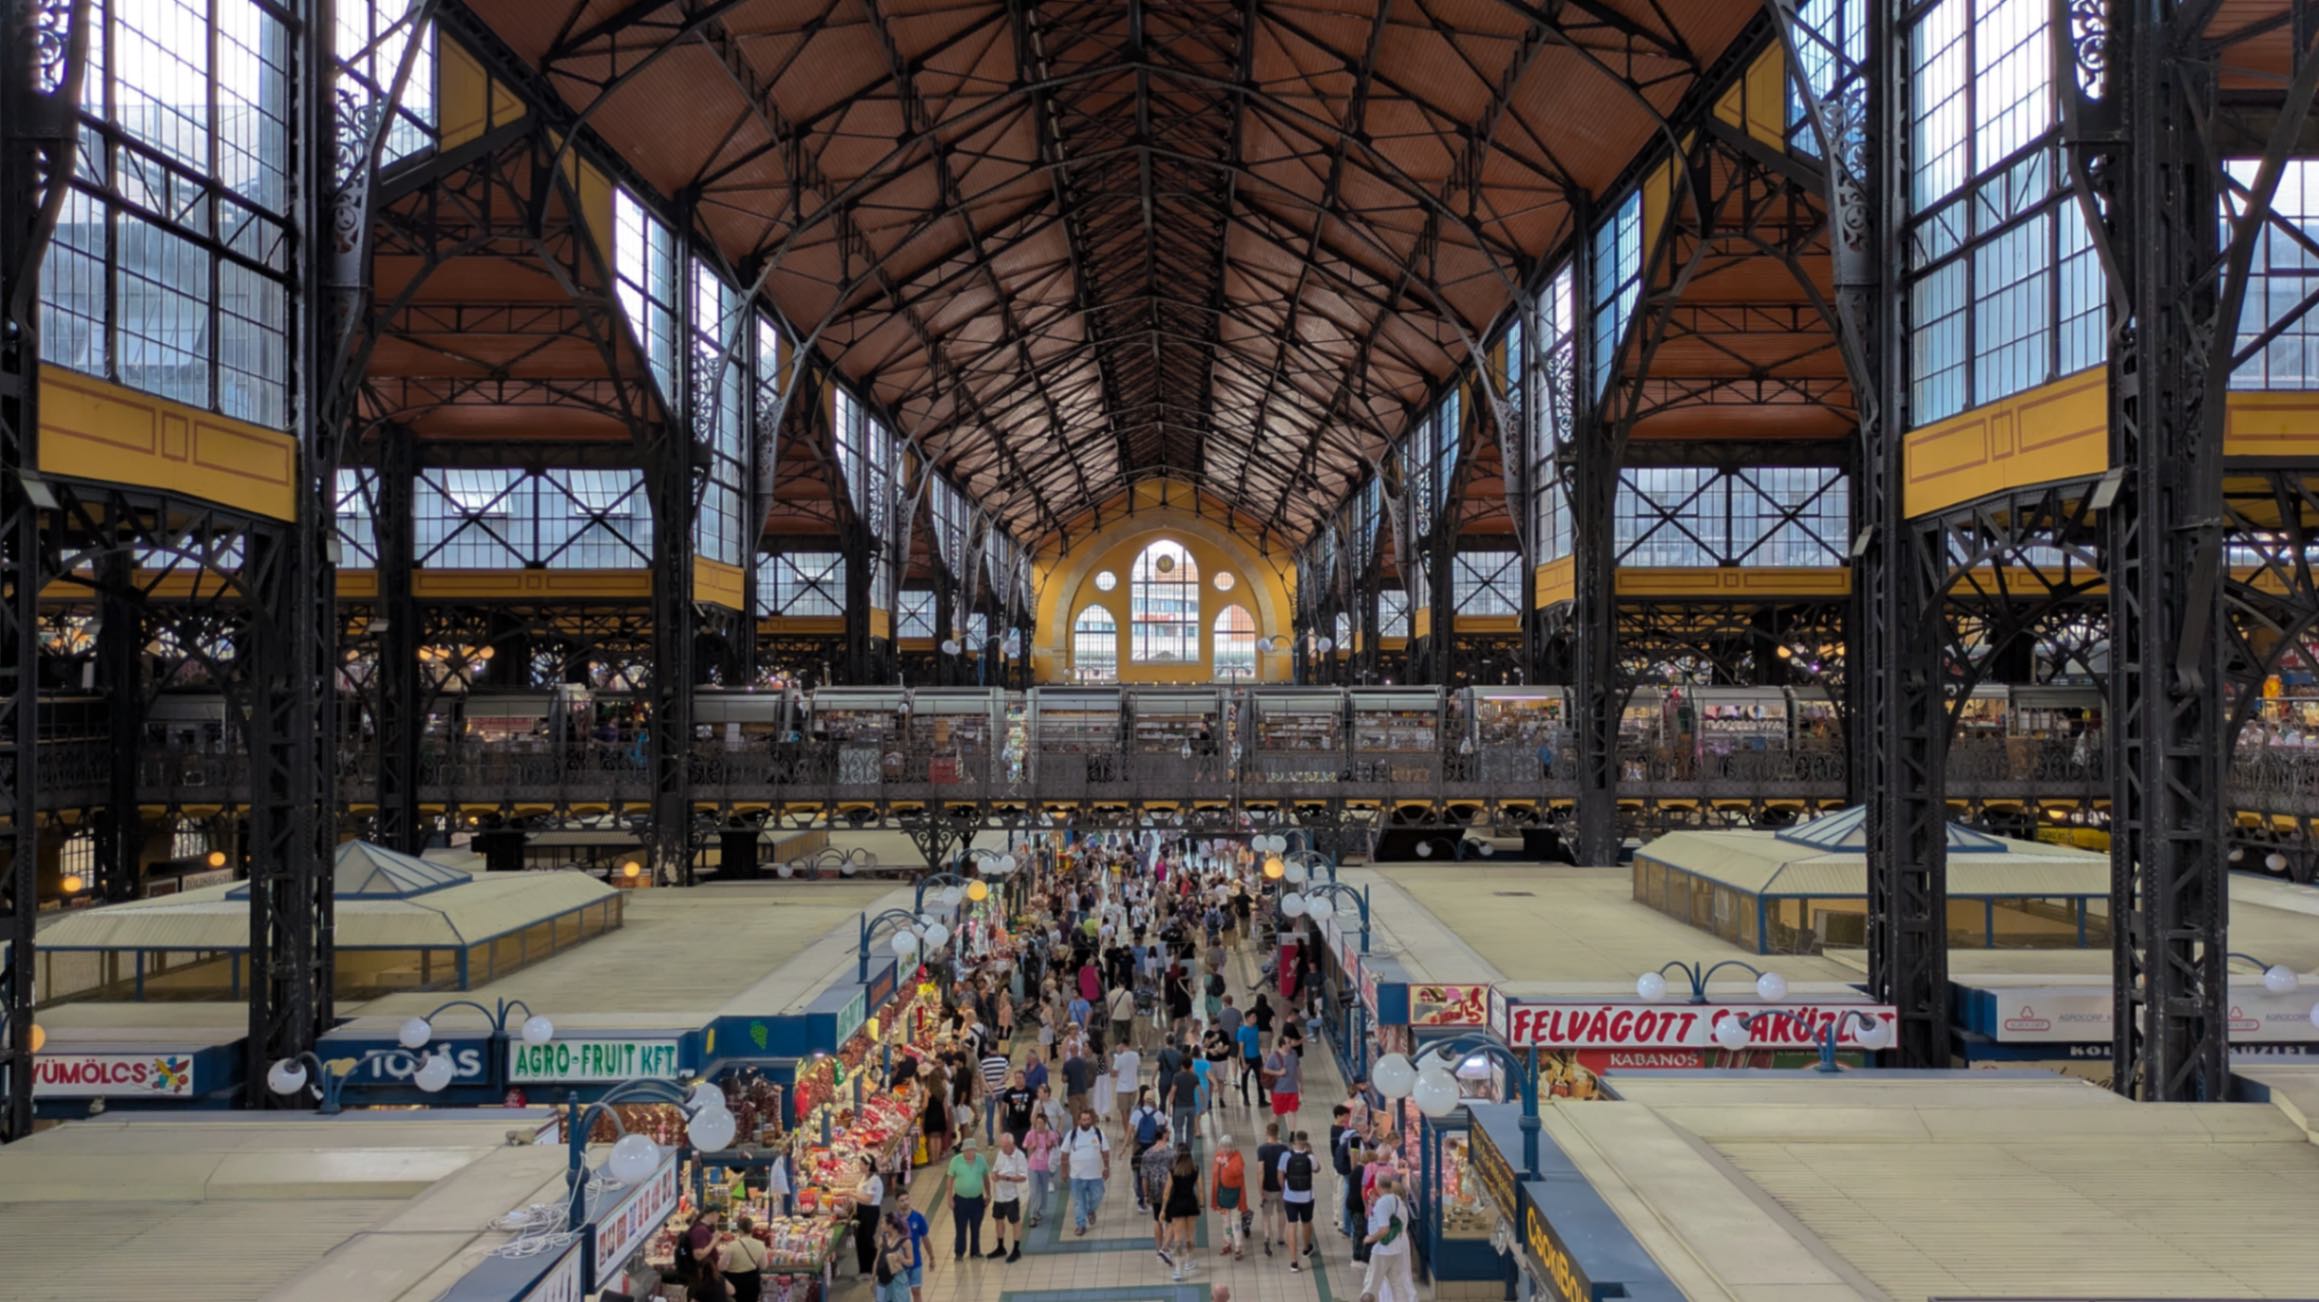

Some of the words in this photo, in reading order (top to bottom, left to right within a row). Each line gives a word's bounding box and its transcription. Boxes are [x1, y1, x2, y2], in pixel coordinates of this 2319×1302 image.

[1513, 1006, 1698, 1043] FELVÁGOTT
[1710, 1006, 1895, 1043] SAKÜZL
[31, 1059, 147, 1084] YÜMÖLCS
[364, 1042, 482, 1078] TOÁS
[515, 1043, 636, 1077] AGRO-FRUIT
[641, 1045, 678, 1076] KFT.
[1610, 1053, 1699, 1067] KABANOS
